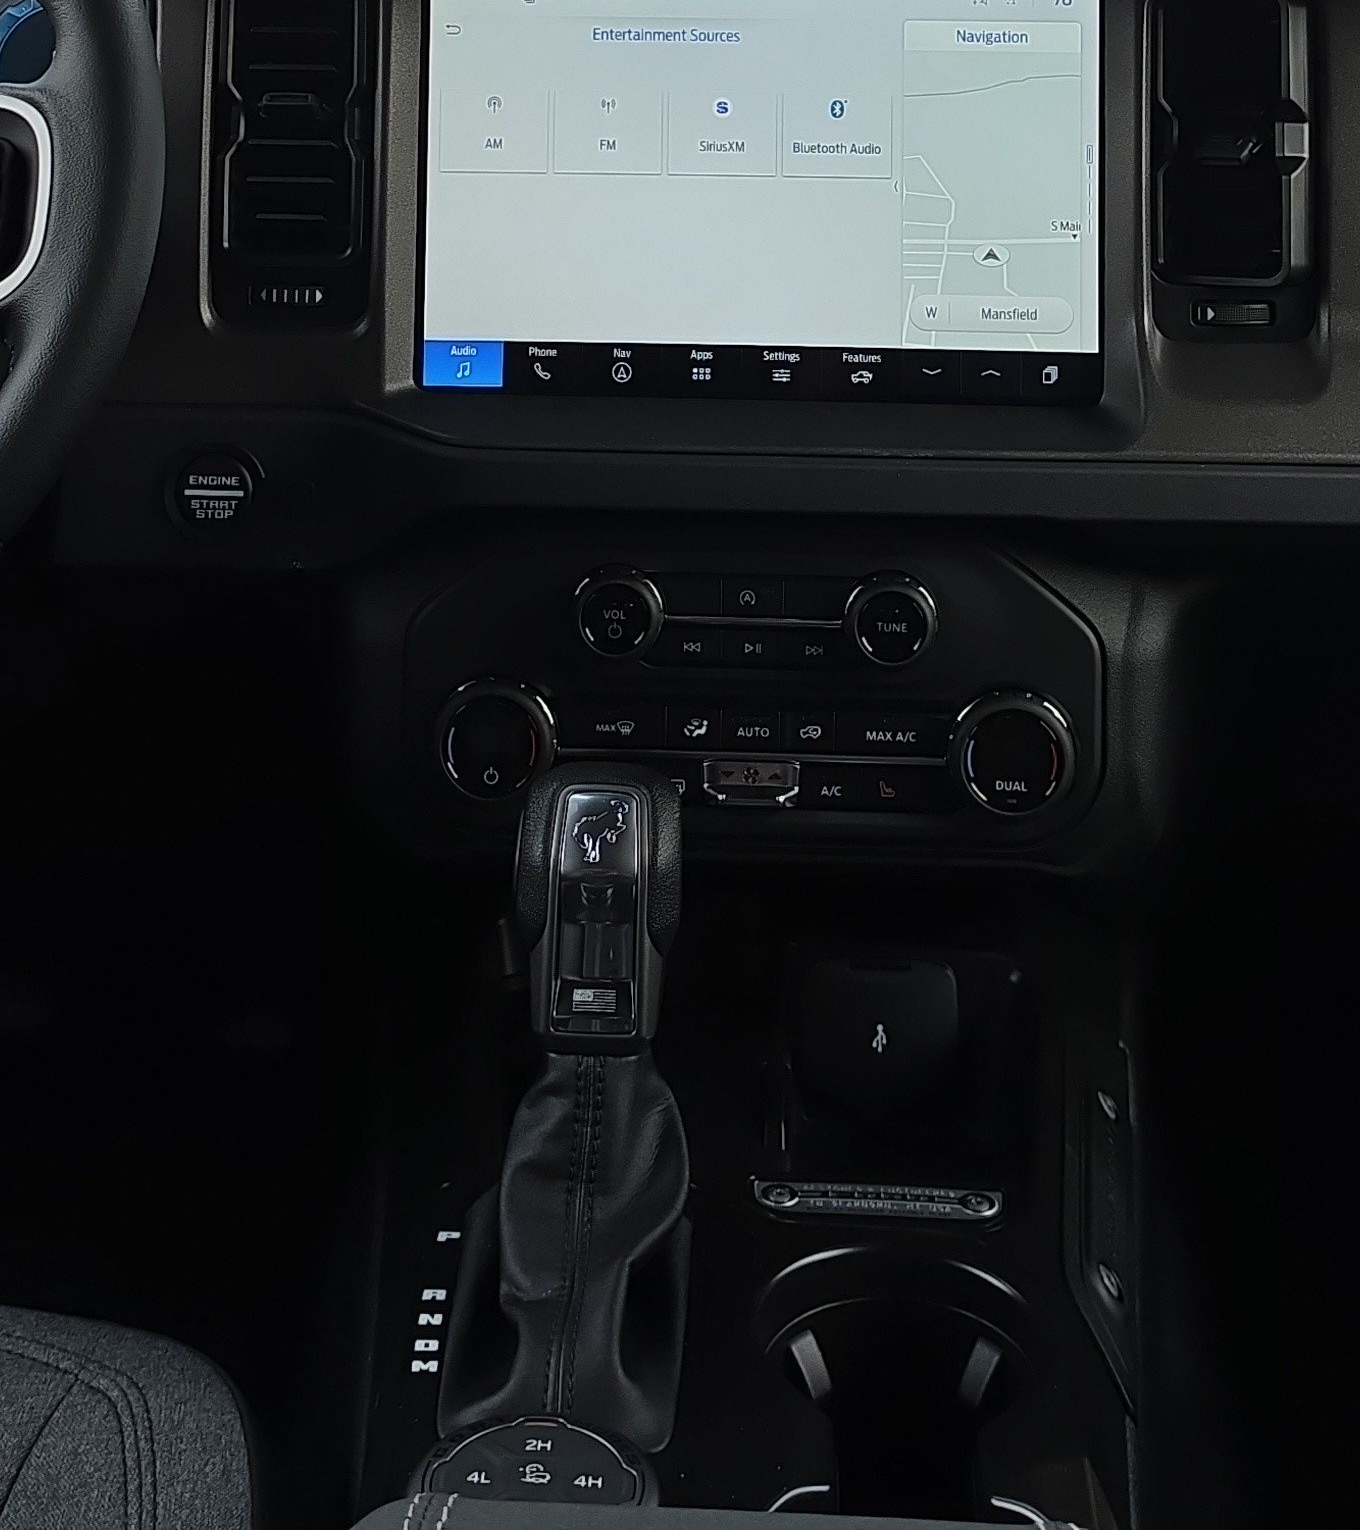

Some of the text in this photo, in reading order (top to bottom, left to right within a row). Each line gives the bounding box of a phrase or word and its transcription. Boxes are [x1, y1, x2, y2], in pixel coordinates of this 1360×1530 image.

[591, 26, 741, 46] Entertainment Sources
[956, 29, 1028, 47] Navigation
[484, 137, 503, 151] AM
[599, 138, 616, 152] FM
[698, 139, 746, 154] SiriusXM
[791, 140, 883, 157] Bluetooth Audio
[1051, 221, 1057, 231] S
[924, 306, 938, 319] W
[980, 306, 1038, 322] Mansfield
[450, 345, 477, 358] Audio
[528, 346, 558, 358] Phone
[612, 348, 632, 359] Nav
[689, 349, 714, 362] Apps
[762, 350, 801, 364] Settings
[841, 352, 882, 364] Features
[189, 475, 240, 486] ENGINE
[191, 500, 238, 510] START
[196, 510, 234, 519] STOP
[603, 609, 626, 621] VOL
[876, 621, 907, 634] TUNE
[596, 722, 616, 733] MAX
[737, 726, 769, 739] AUTO
[866, 730, 917, 744] MAX A/C
[820, 784, 842, 798] A/C
[995, 779, 1028, 793] DUAL
[437, 1231, 461, 1242] P
[422, 1289, 446, 1301] R
[419, 1313, 443, 1325] N
[414, 1338, 439, 1352] D
[411, 1360, 439, 1373] M
[525, 1439, 552, 1452] 2H
[466, 1471, 491, 1484] 4L
[573, 1475, 603, 1489] 4H
